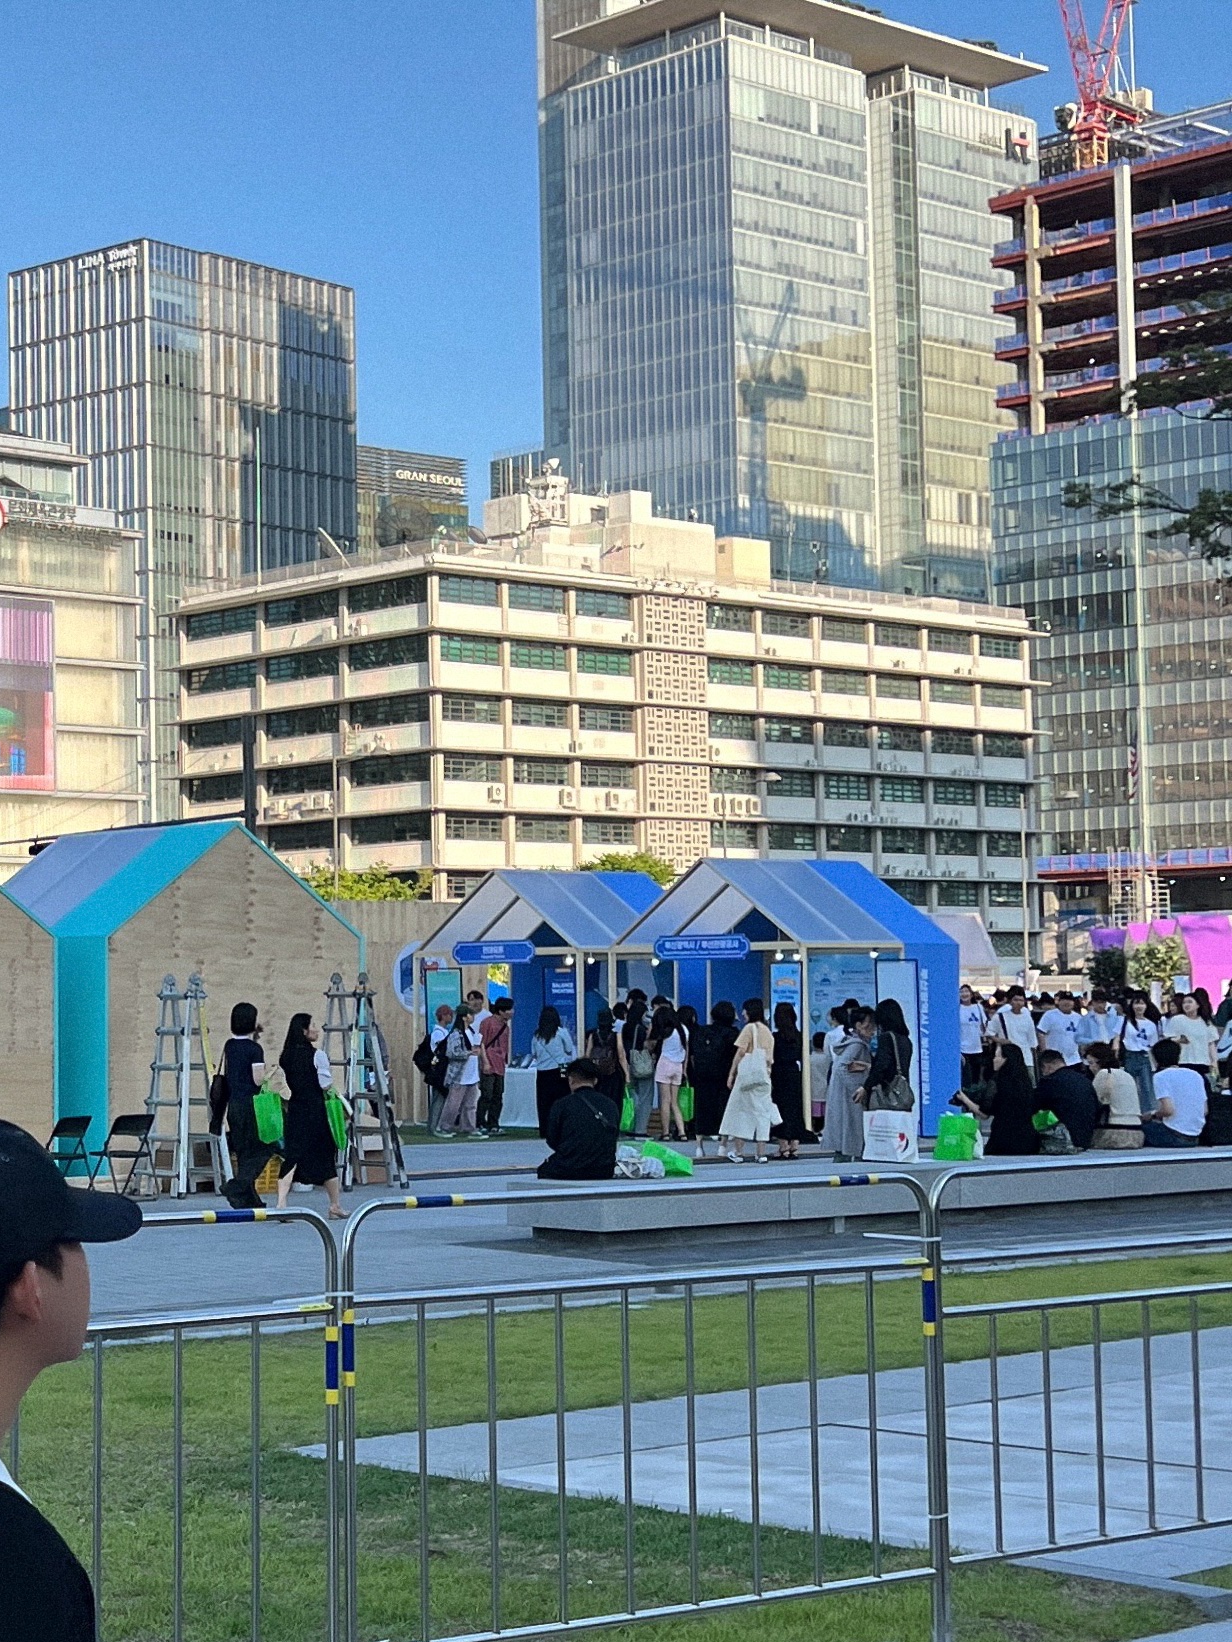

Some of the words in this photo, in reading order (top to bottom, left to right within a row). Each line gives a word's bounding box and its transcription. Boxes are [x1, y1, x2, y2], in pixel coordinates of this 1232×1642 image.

[1005, 128, 1030, 165] kt
[78, 252, 105, 269] LINA
[395, 469, 428, 482] GRAN
[429, 473, 465, 487] SEOUL
